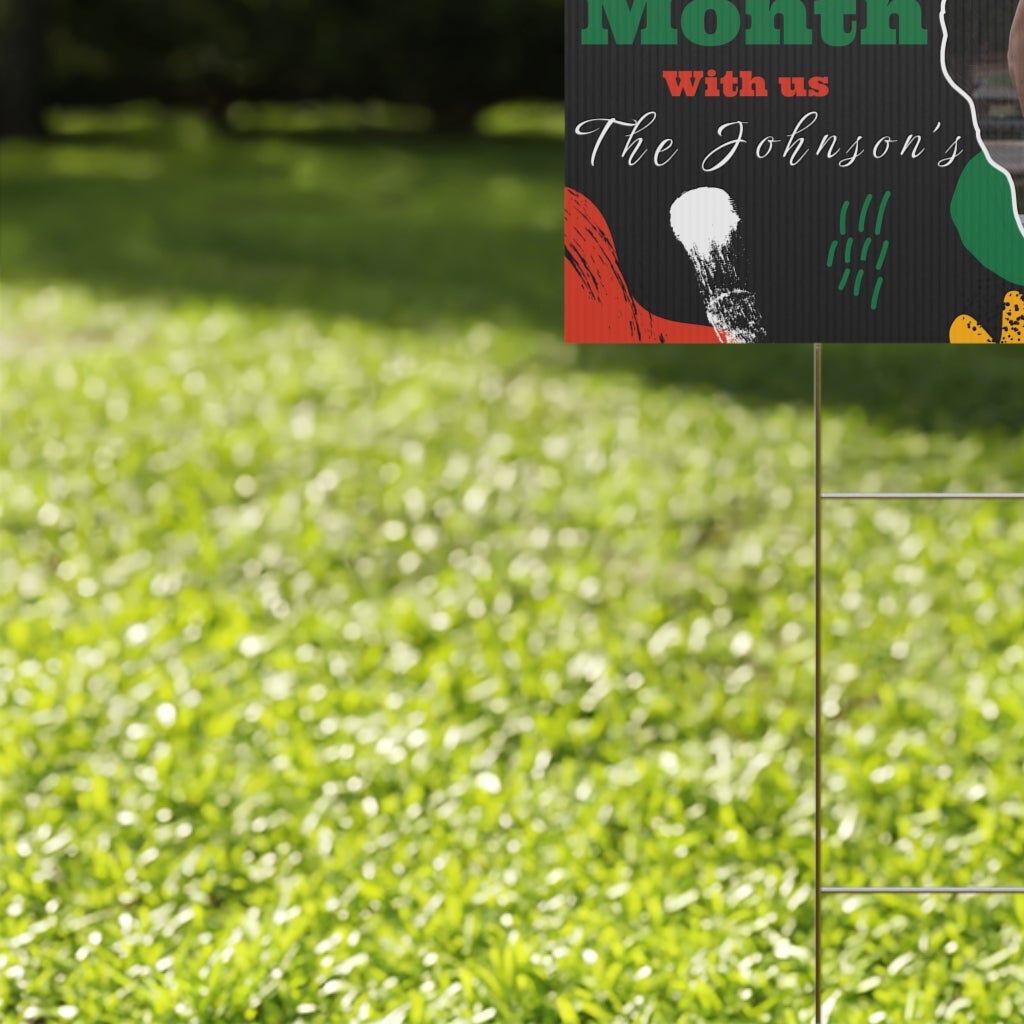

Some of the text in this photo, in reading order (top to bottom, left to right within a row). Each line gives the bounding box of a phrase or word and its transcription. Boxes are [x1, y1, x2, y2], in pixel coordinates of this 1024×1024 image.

[662, 69, 829, 98] With us
[574, 110, 964, 172] The Johnson's
